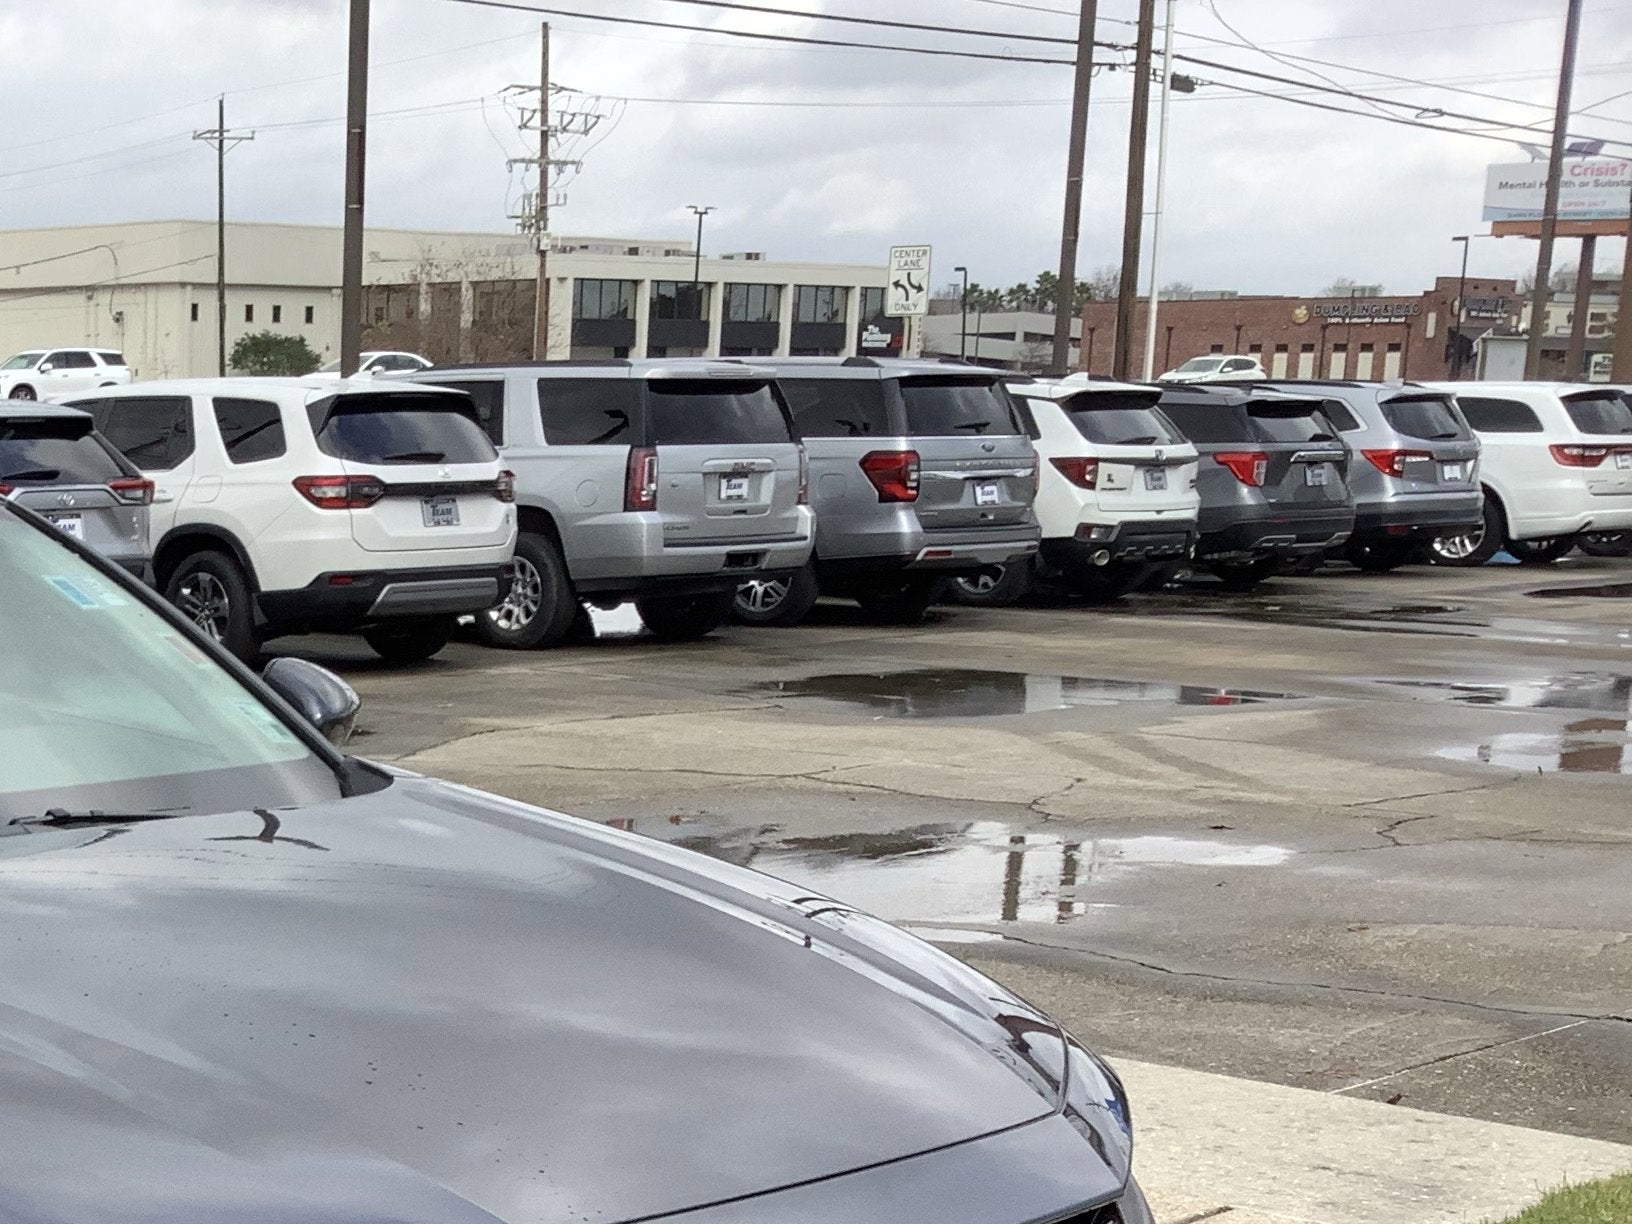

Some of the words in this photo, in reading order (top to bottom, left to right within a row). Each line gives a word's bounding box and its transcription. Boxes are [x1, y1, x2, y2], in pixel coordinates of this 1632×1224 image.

[1570, 162, 1628, 177] Crisis?
[1498, 180, 1537, 190] Mental
[1539, 180, 1577, 189] Hlth
[893, 248, 928, 259] CENTER
[898, 259, 922, 268] LANE
[894, 302, 919, 312] ONLY
